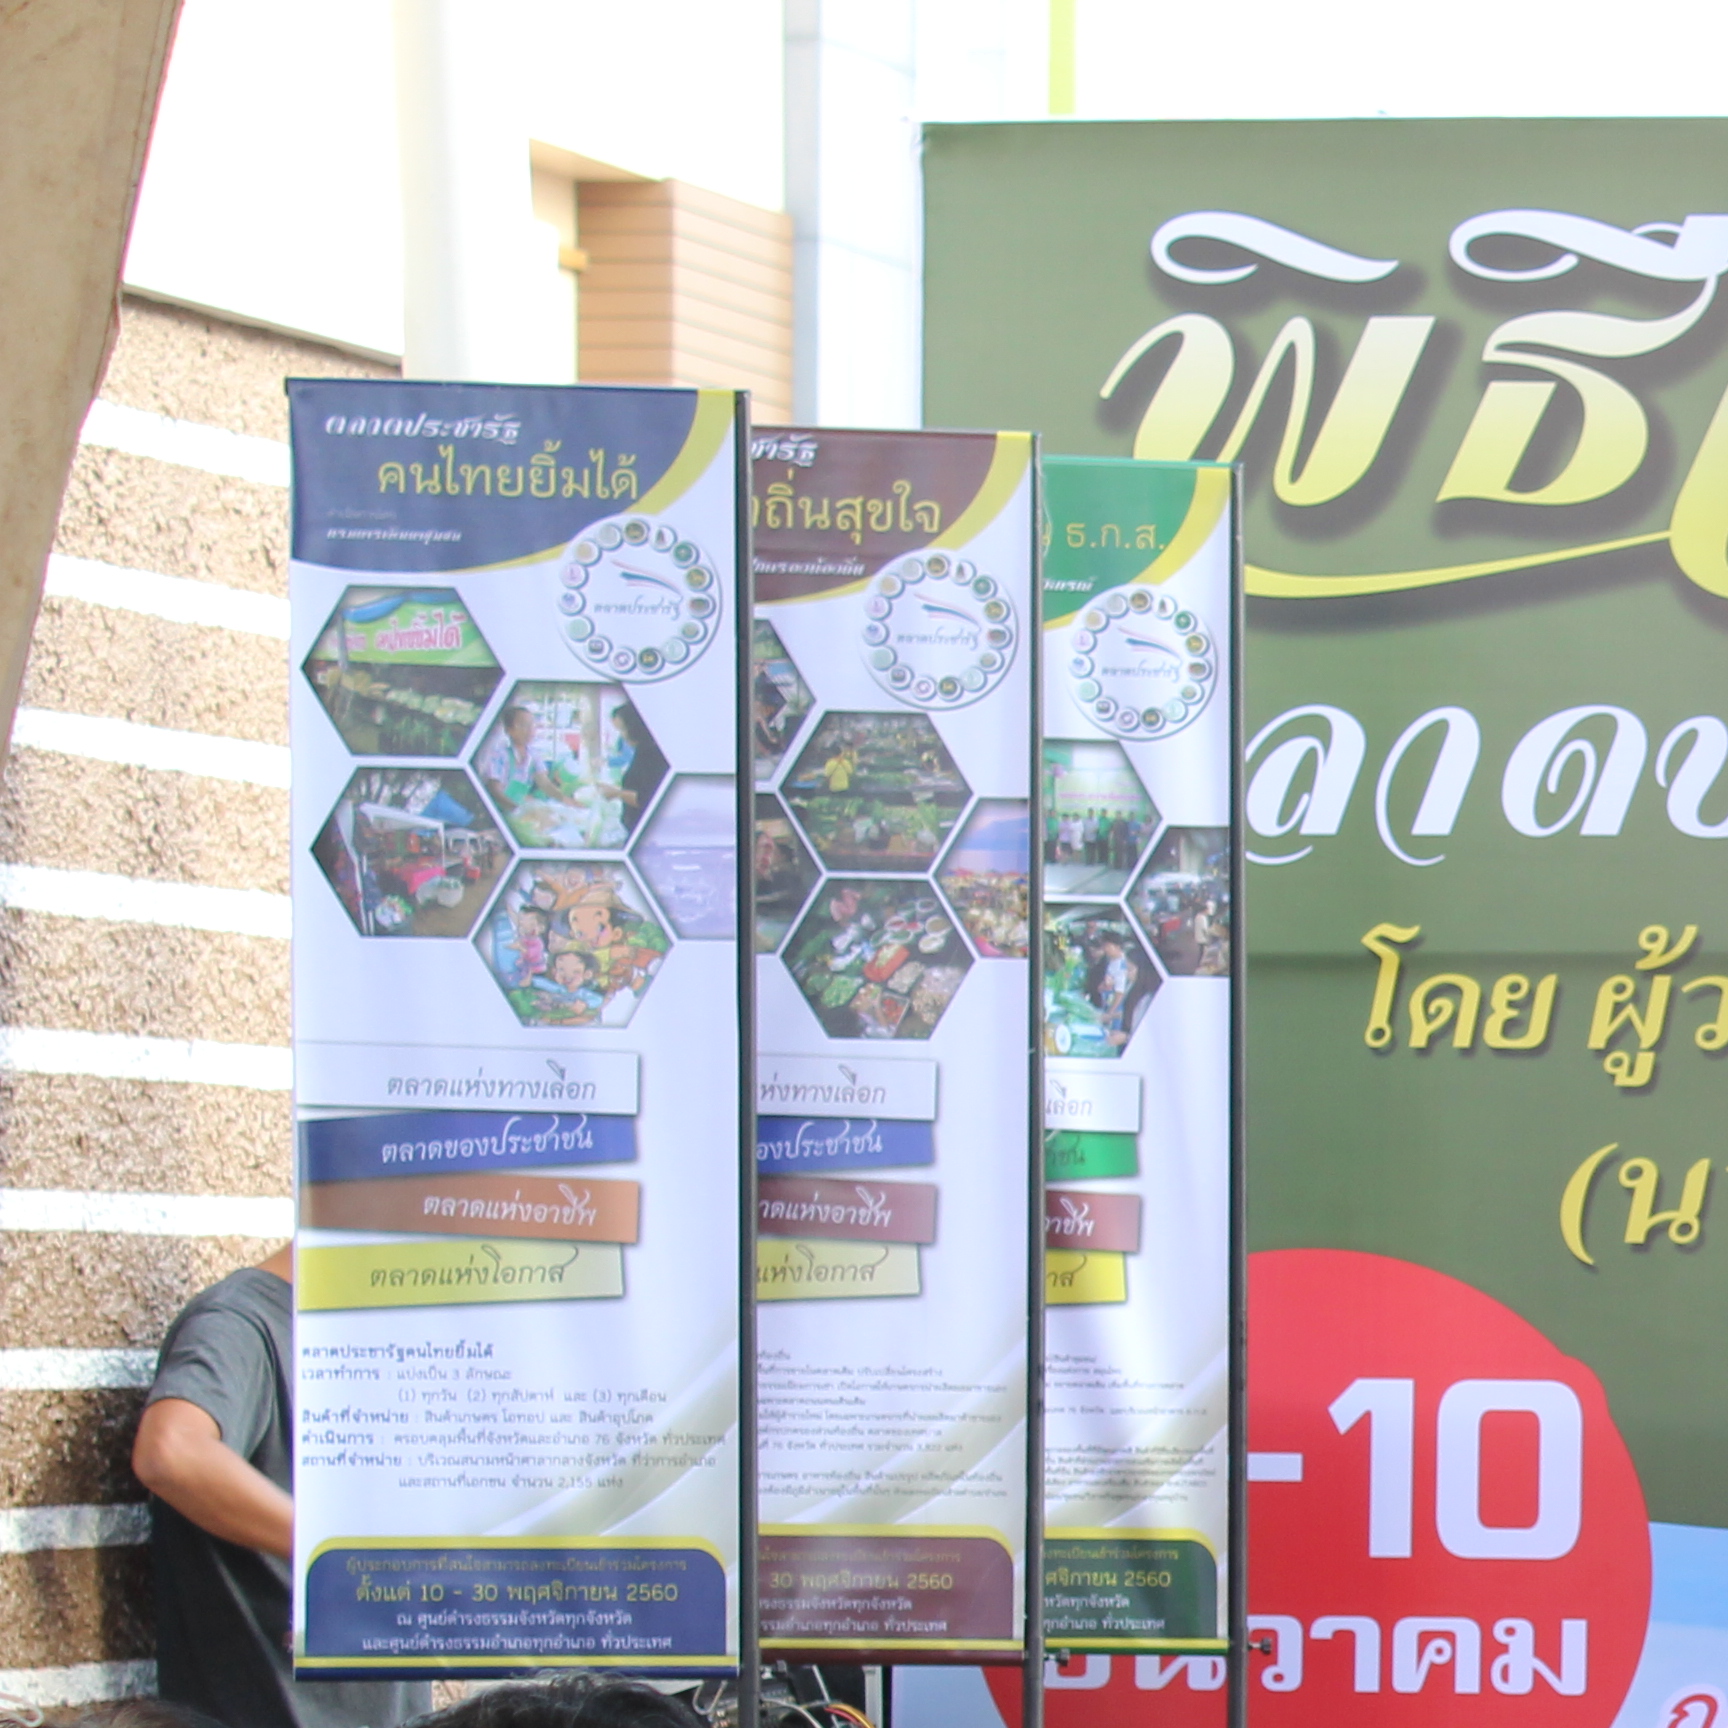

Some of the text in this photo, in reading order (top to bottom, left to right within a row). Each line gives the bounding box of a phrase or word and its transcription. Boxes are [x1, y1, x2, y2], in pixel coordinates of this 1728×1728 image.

[325, 412, 522, 444] ตลาดประชารัฐ
[378, 440, 639, 500] คนไทยยิ้มได้
[1361, 923, 1557, 1050] โดย
[387, 1060, 596, 1101] ตลาดแห่งทางเลือก
[382, 1115, 593, 1165] ตลาดของประชาชน
[423, 1185, 597, 1226] ตลาดแห่งอาชีพ
[370, 1245, 579, 1288] ตลาดแห่งโอกาส
[302, 1342, 494, 1362] ตลาดประชารัฐคนไทยยิ้มได้
[356, 1578, 678, 1605] ตั้งแต่ 10 30 พฤศจิกายน 2560
[770, 1573, 792, 1589] 30
[907, 1573, 954, 1590] 2560
[1124, 1570, 1172, 1588] 2560
